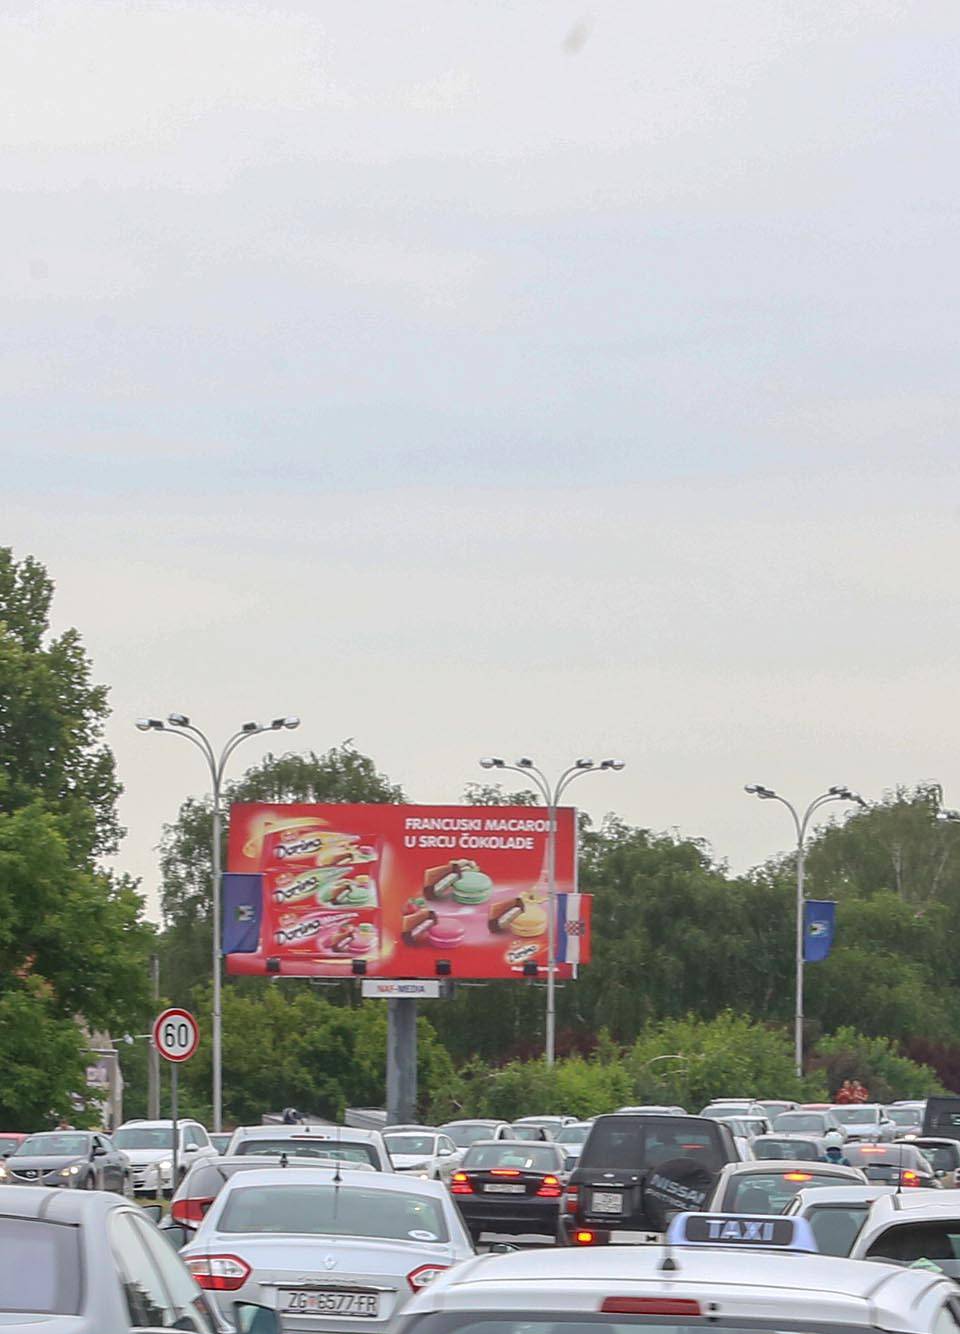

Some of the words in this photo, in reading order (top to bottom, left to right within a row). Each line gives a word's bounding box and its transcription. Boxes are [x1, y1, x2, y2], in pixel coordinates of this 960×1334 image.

[404, 818, 481, 831] FRANCUSKI
[404, 836, 416, 848] U
[419, 835, 456, 848] SRCU
[459, 832, 534, 849] ČOKOLADE
[164, 1023, 188, 1048] 60
[705, 1220, 774, 1241] TAXI
[288, 1293, 307, 1309] ZG
